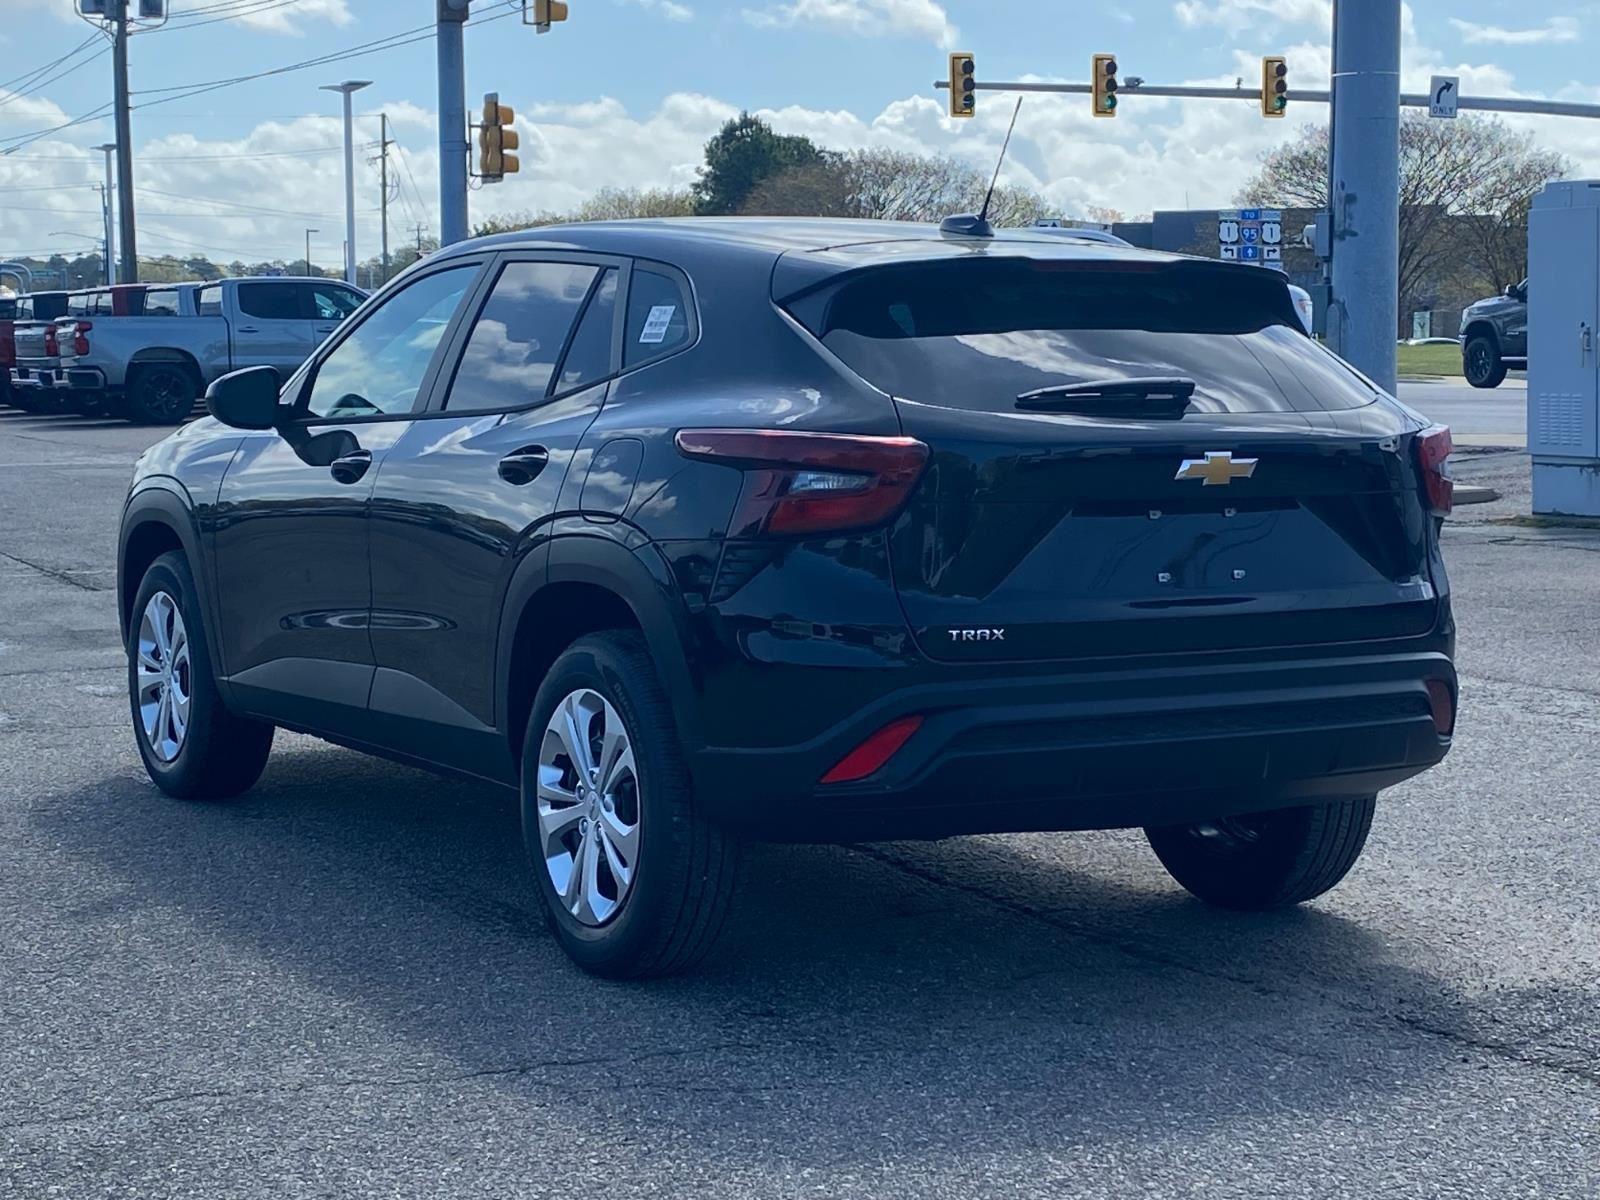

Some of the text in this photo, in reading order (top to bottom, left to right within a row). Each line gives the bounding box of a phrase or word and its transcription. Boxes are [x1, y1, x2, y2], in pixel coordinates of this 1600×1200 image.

[1432, 105, 1454, 115] ONLY
[1244, 211, 1255, 219] TO
[1242, 228, 1257, 240] 95
[948, 628, 1005, 641] TRAX
